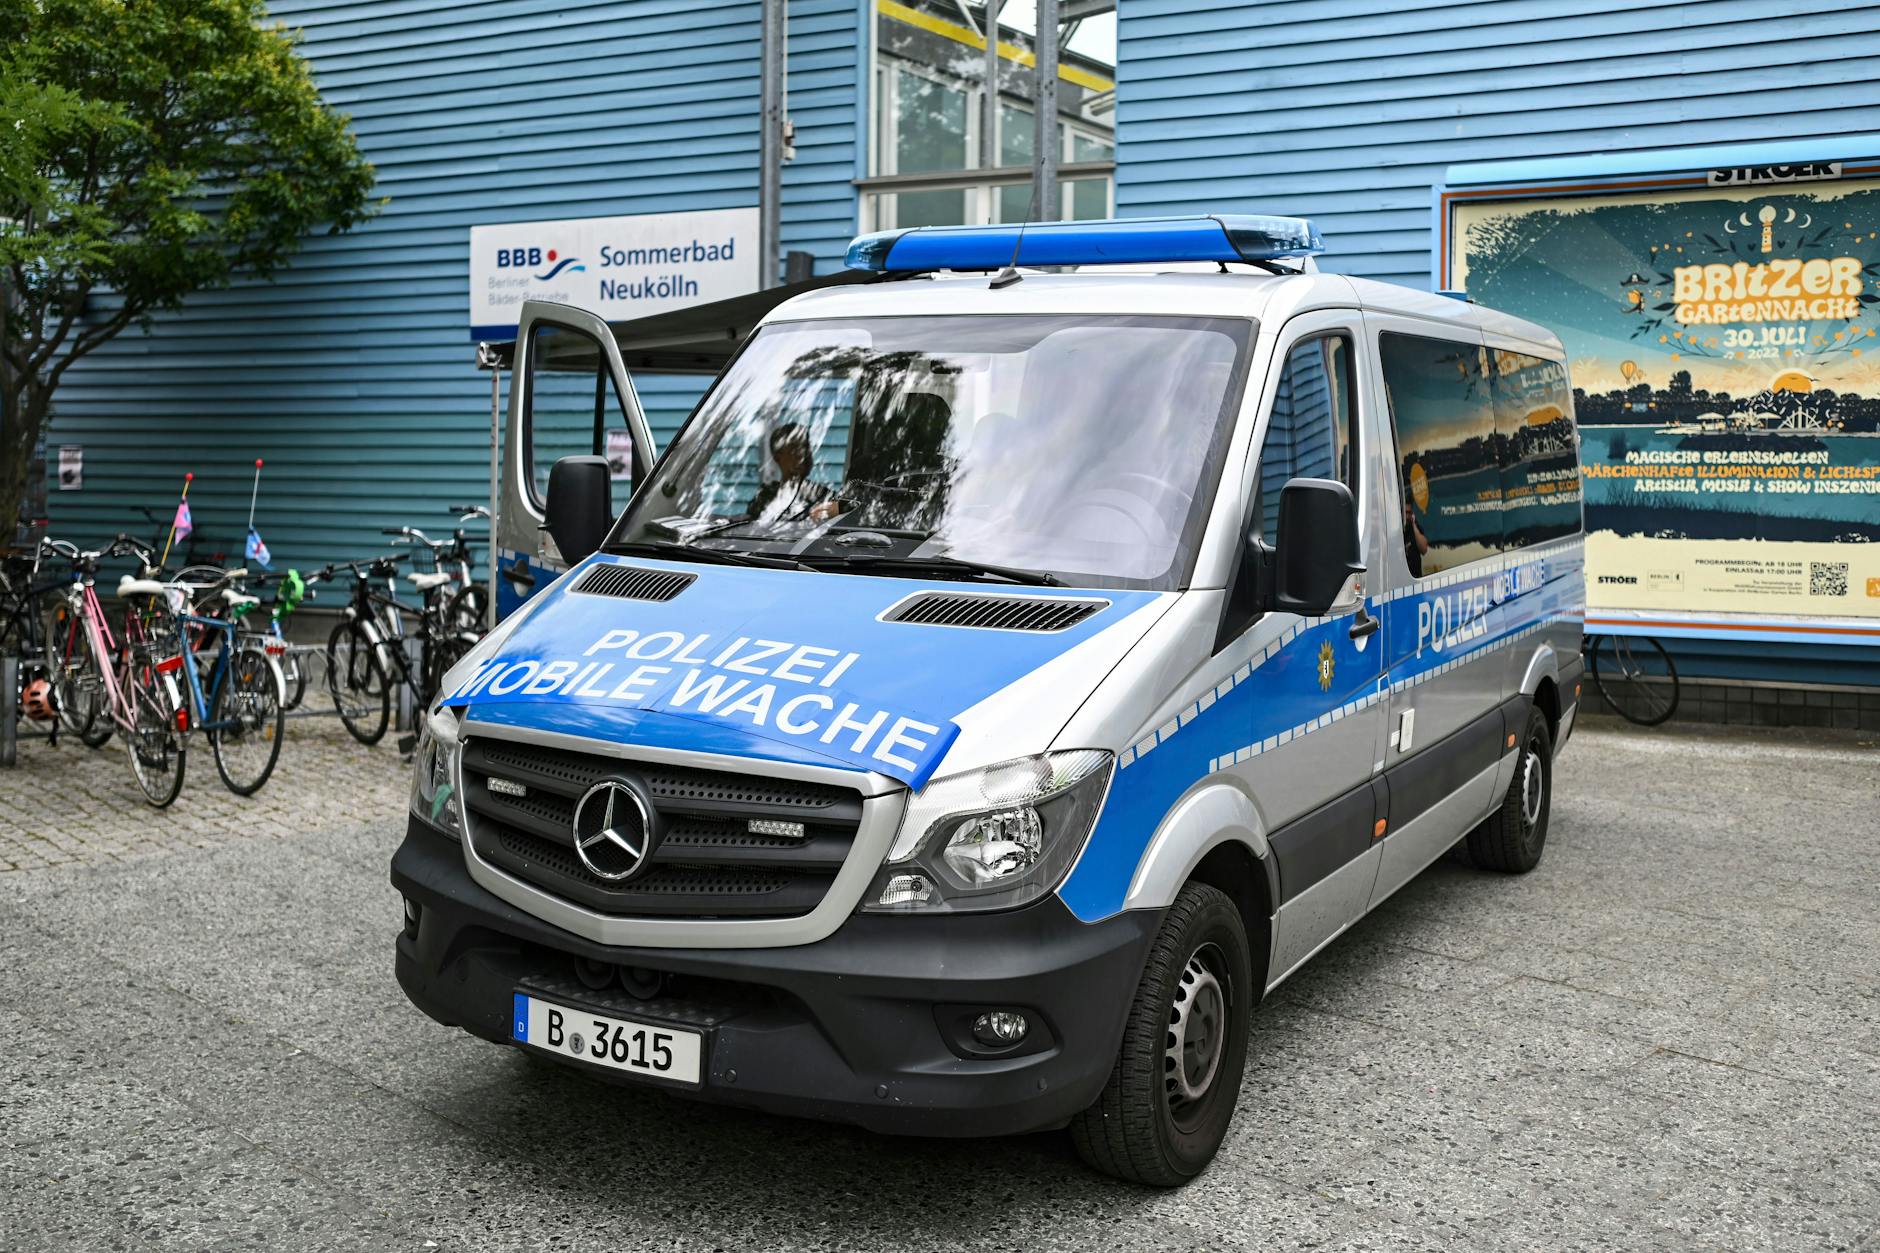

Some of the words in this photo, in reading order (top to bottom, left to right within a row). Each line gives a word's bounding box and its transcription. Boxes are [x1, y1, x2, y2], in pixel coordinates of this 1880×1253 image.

[497, 247, 542, 268] BBB
[599, 238, 735, 267] Sommerbad
[488, 277, 529, 289] Berliner
[600, 276, 698, 301] Neukölln
[1747, 347, 1780, 360] 2022
[1803, 465, 1817, 479] &
[1753, 480, 1764, 493] &
[1767, 480, 1811, 494] SHOW
[1416, 584, 1489, 659] POLIZEI
[583, 628, 860, 688] POLIZEI
[457, 660, 673, 701] MOBILE
[670, 669, 940, 773] WACHE
[518, 1021, 525, 1033] D
[547, 1008, 564, 1047] B
[590, 1020, 673, 1071] 3615
